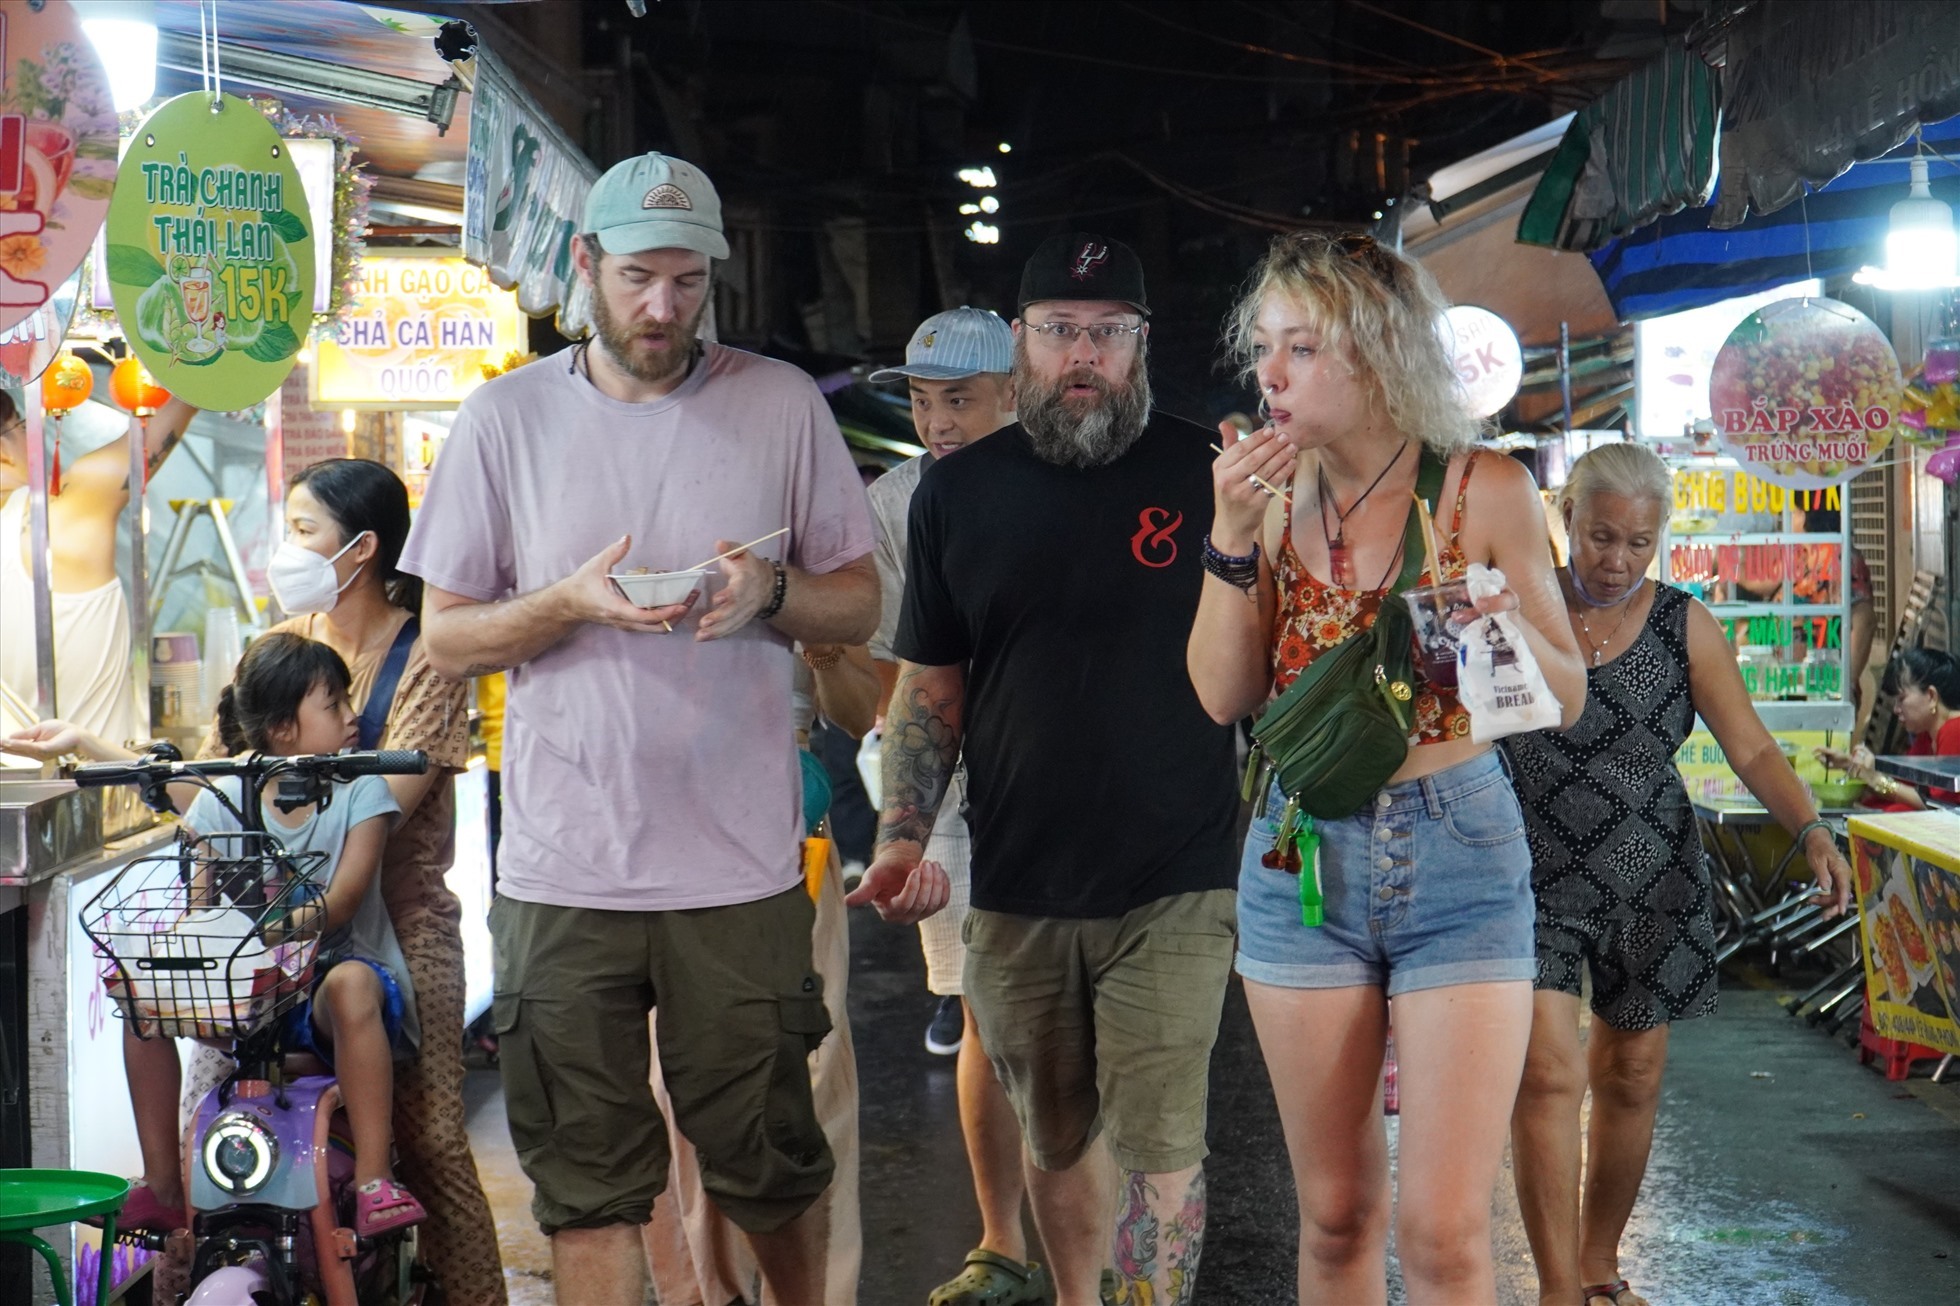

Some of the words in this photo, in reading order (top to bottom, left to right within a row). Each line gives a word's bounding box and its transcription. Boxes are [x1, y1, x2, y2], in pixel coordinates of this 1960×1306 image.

[142, 150, 193, 206] TRÀ
[154, 207, 217, 259] THÁI
[226, 221, 273, 261] LAN
[219, 264, 290, 323] 15K
[400, 268, 450, 300] GẠO
[398, 313, 430, 346] CÁ
[442, 314, 494, 346] HÀN
[381, 357, 449, 399] QUỐC
[1723, 397, 1800, 434] BẮP
[1808, 400, 1891, 433] XÀO
[1745, 438, 1812, 462] TRỨNG
[1818, 434, 1867, 462] MUỐI
[1130, 506, 1183, 568] &
[1748, 611, 1793, 647] MÀU
[1803, 616, 1841, 650] 17K
